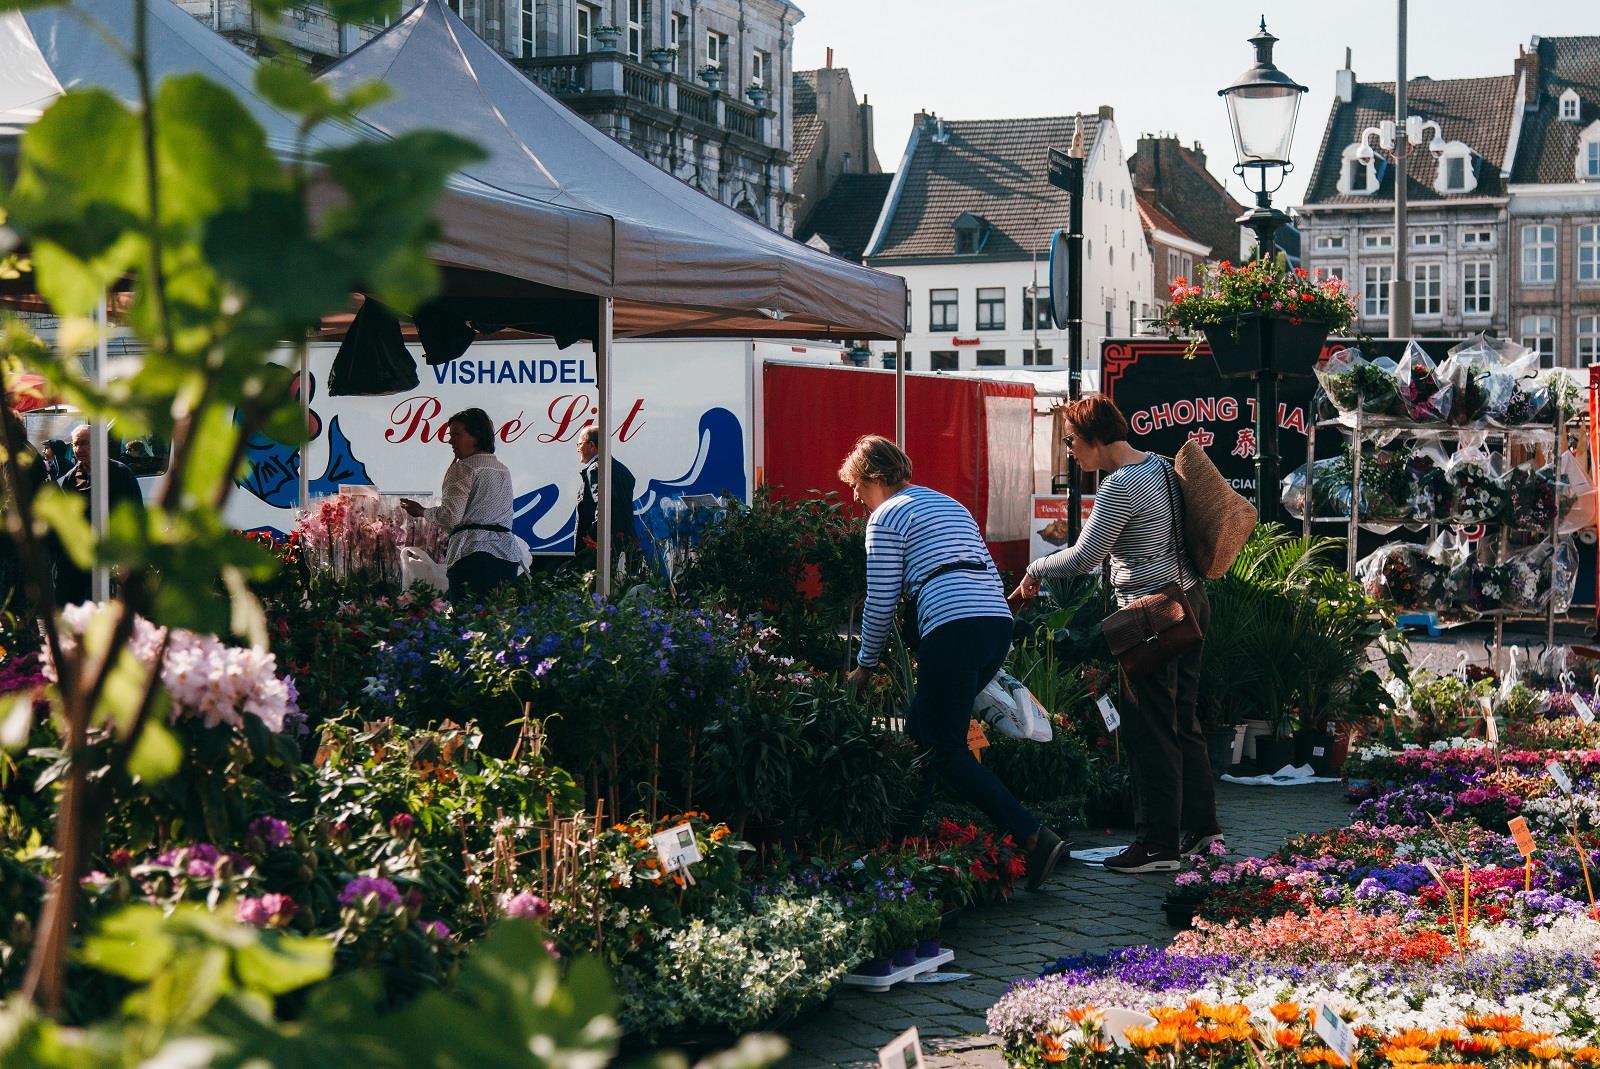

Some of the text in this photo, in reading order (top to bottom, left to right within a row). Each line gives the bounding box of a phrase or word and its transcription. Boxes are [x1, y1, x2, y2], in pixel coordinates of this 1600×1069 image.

[432, 360, 595, 385] VISHANDEL
[384, 394, 647, 444] Reé Lit
[1131, 397, 1239, 436] CHONG
